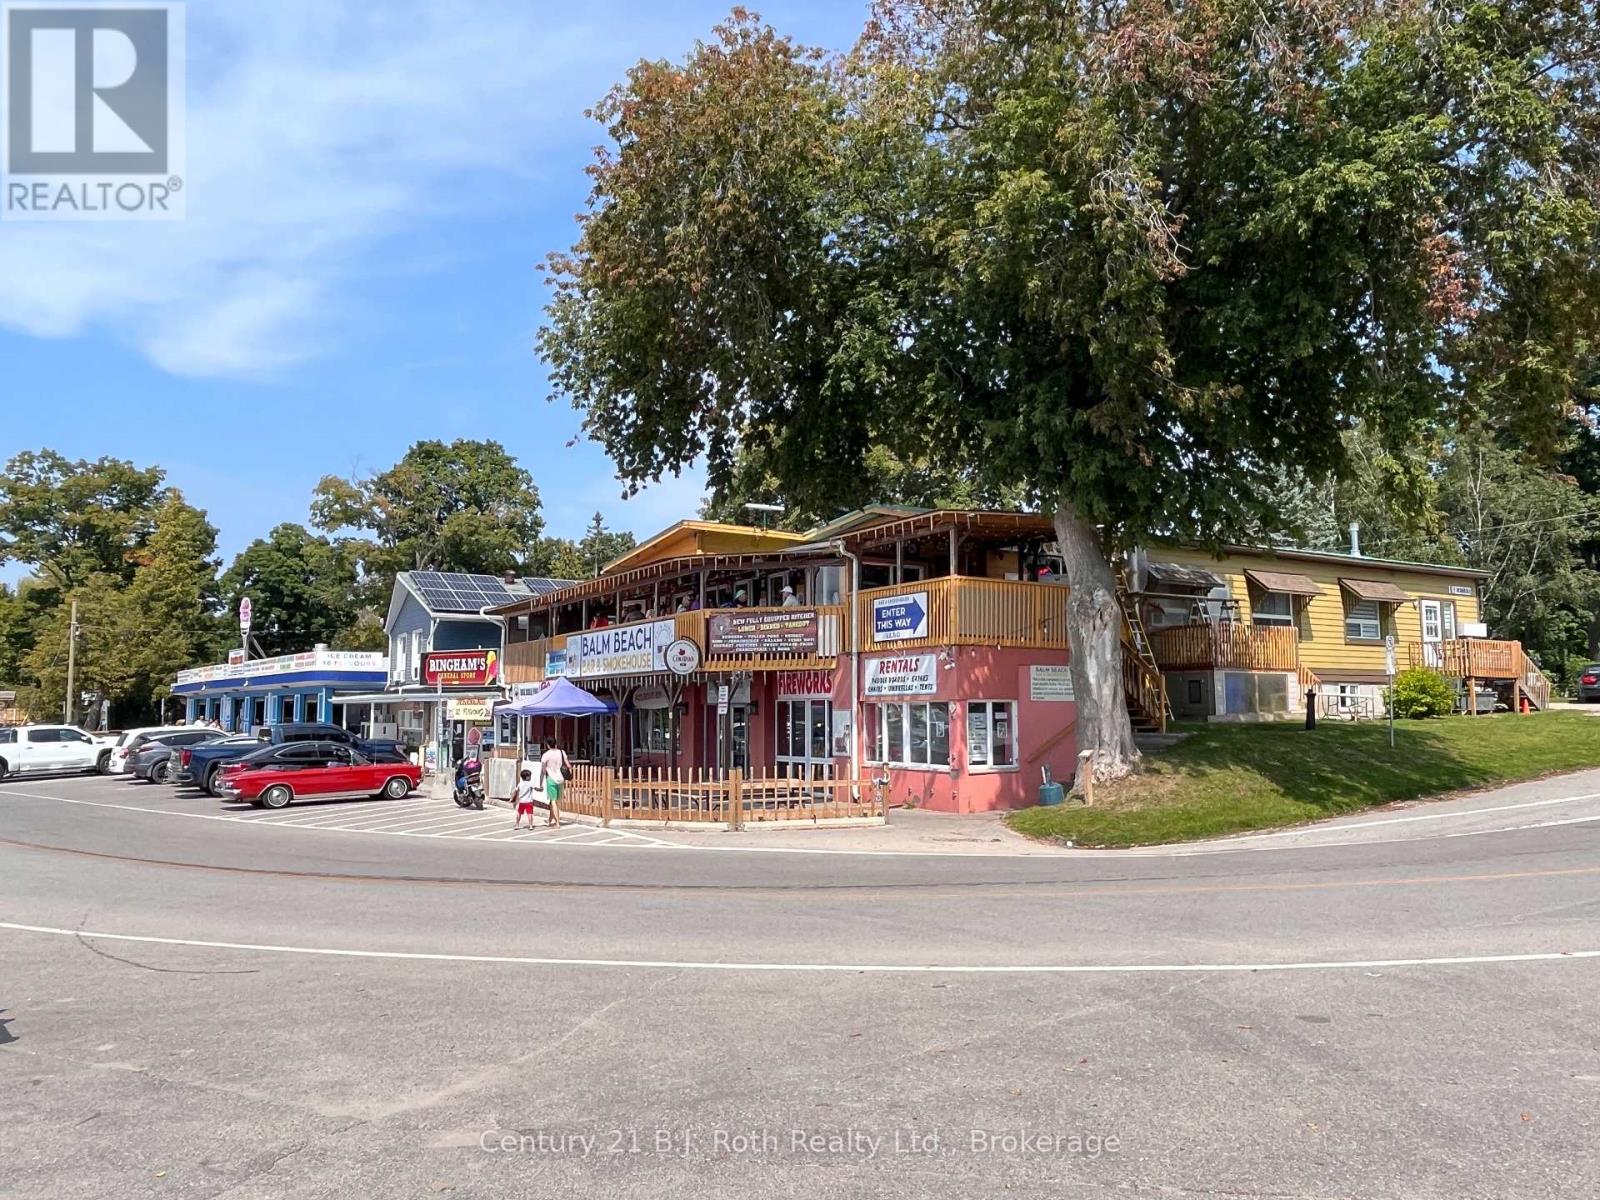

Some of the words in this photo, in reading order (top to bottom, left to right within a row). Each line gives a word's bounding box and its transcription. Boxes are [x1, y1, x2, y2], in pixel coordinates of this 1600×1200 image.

[881, 607, 906, 618] ENTER
[877, 620, 893, 630] THIS
[894, 618, 912, 627] WAY
[582, 634, 610, 656] BALM
[613, 626, 652, 653] BEACH
[429, 658, 486, 672] BINGHAM'S
[582, 659, 595, 673] BAR
[602, 653, 652, 671] SMOKEHOUSE
[879, 658, 920, 674] RENTALS
[778, 671, 833, 695] FIREWORKS
